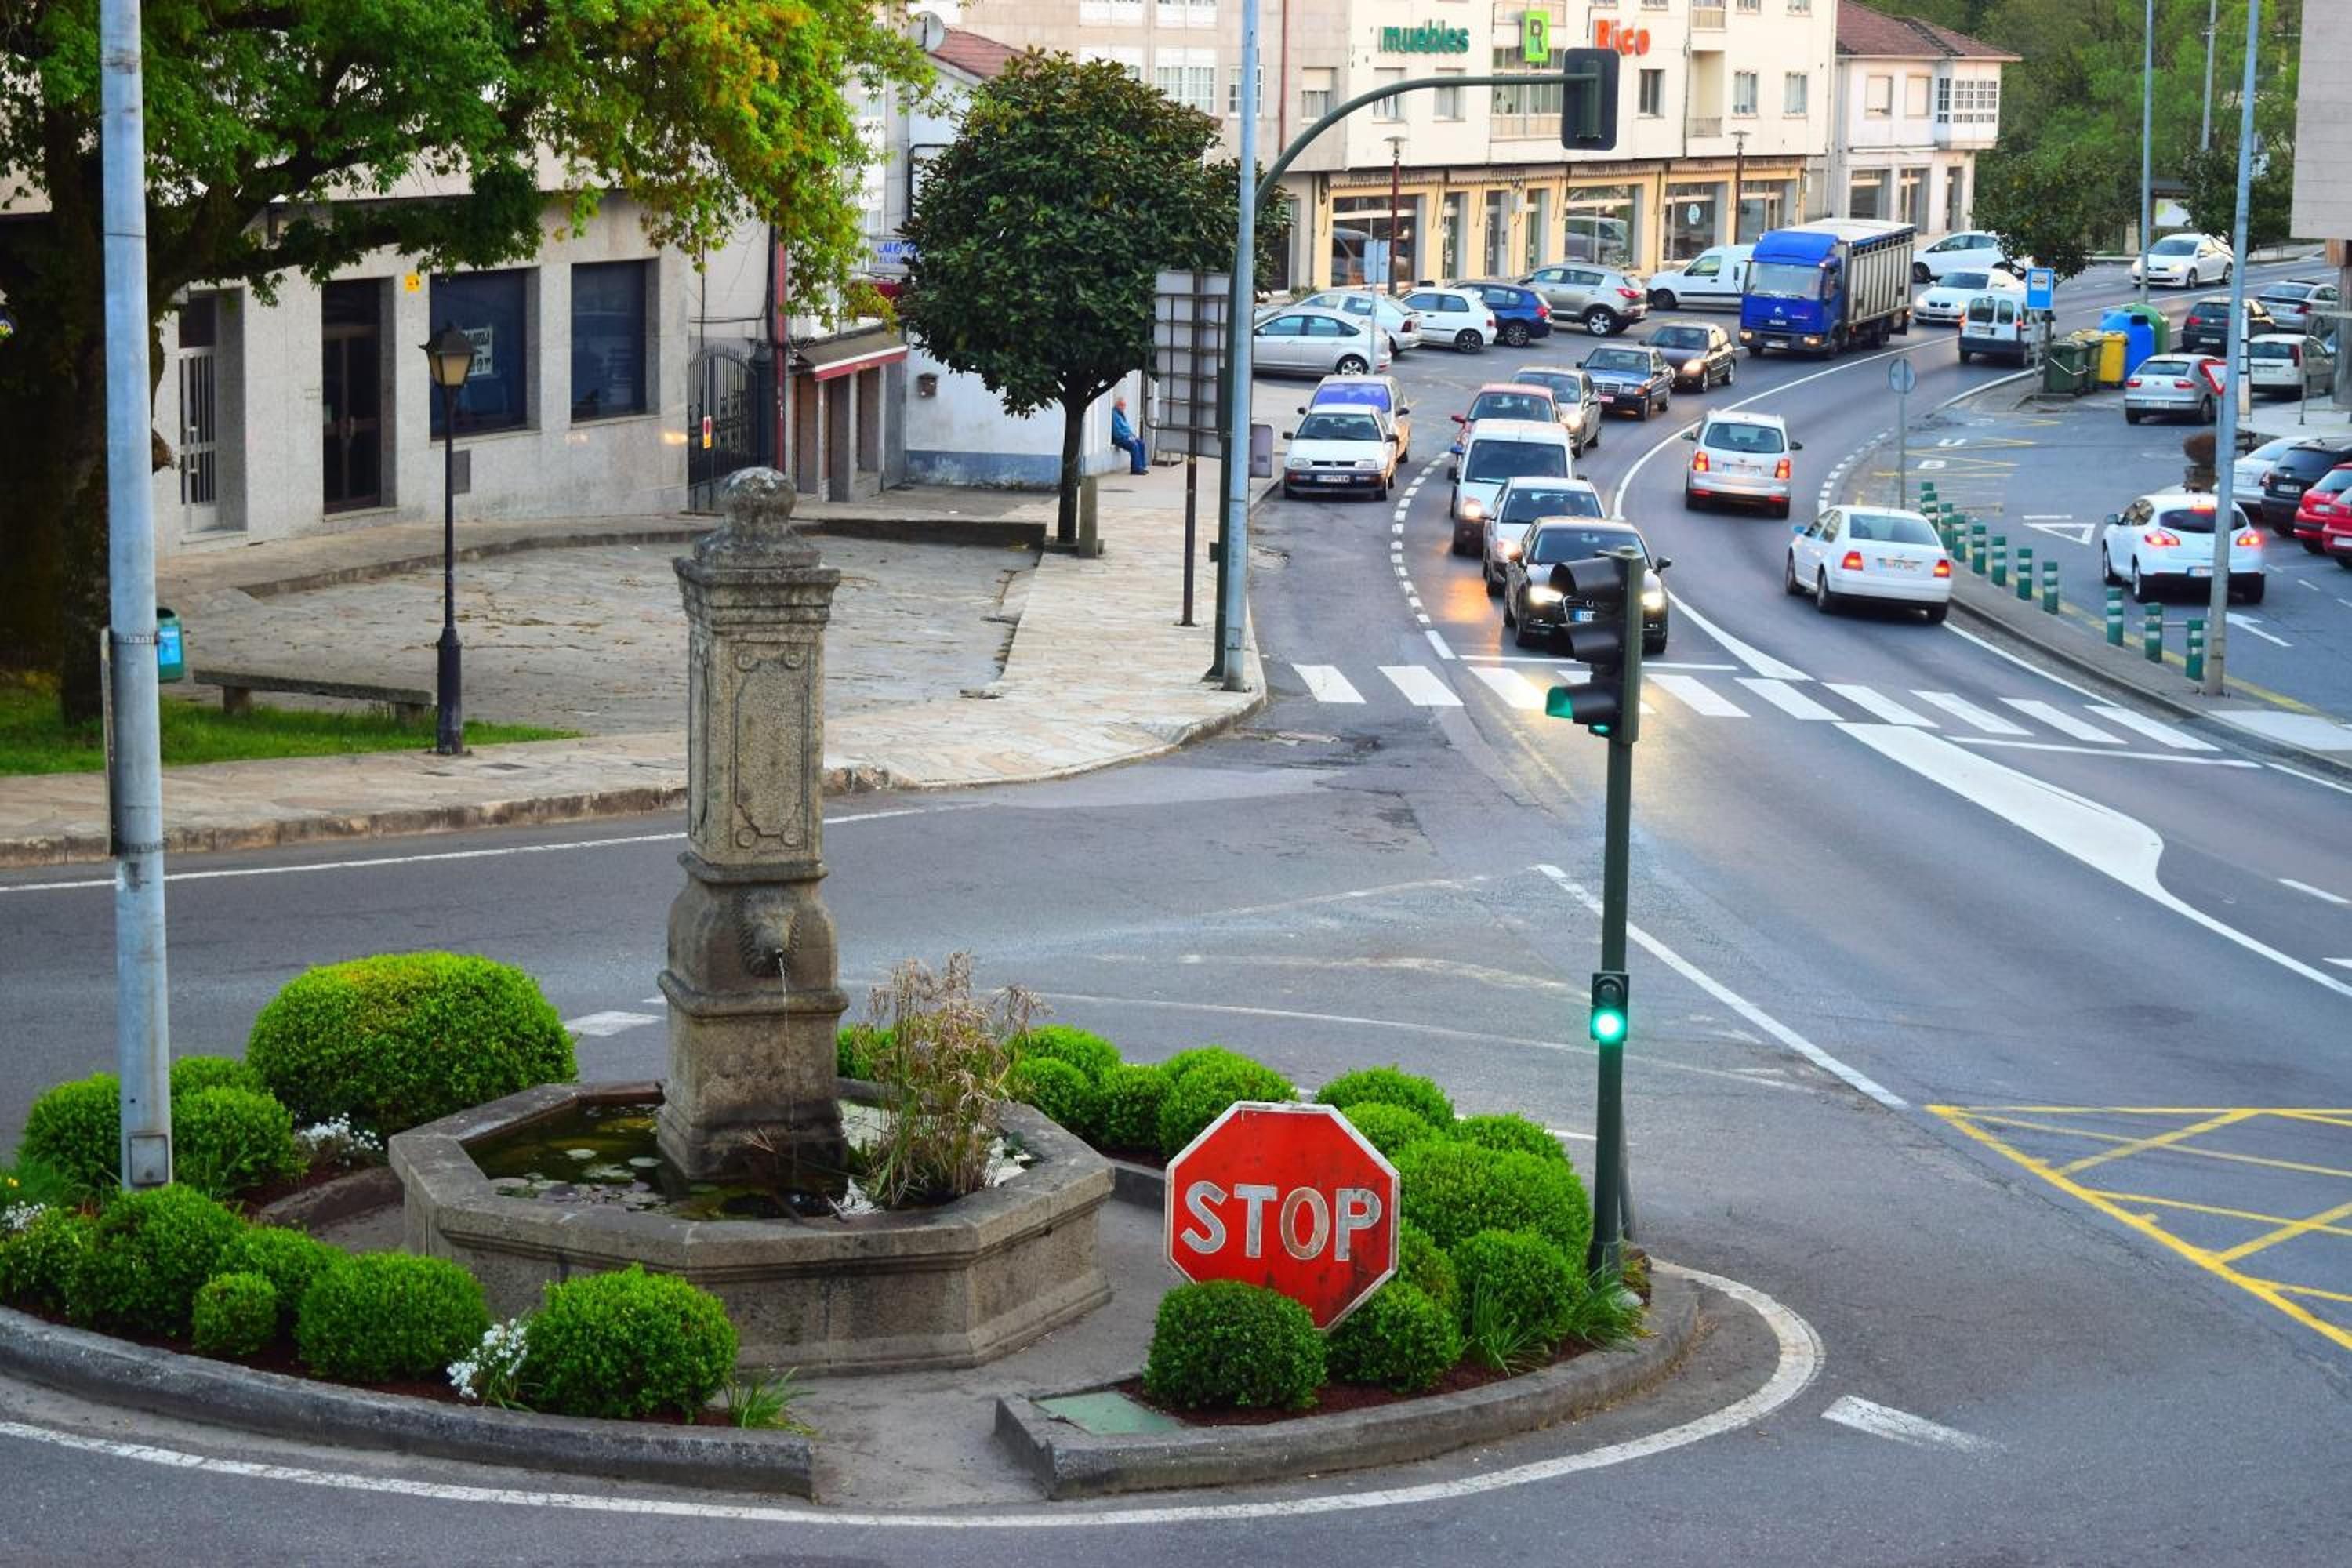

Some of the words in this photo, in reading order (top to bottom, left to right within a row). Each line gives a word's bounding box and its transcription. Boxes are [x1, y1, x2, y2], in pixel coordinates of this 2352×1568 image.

[1378, 19, 1469, 53] muebles
[1530, 19, 1543, 53] R
[1594, 20, 1650, 56] Rico
[1180, 1180, 1382, 1261] STOP
